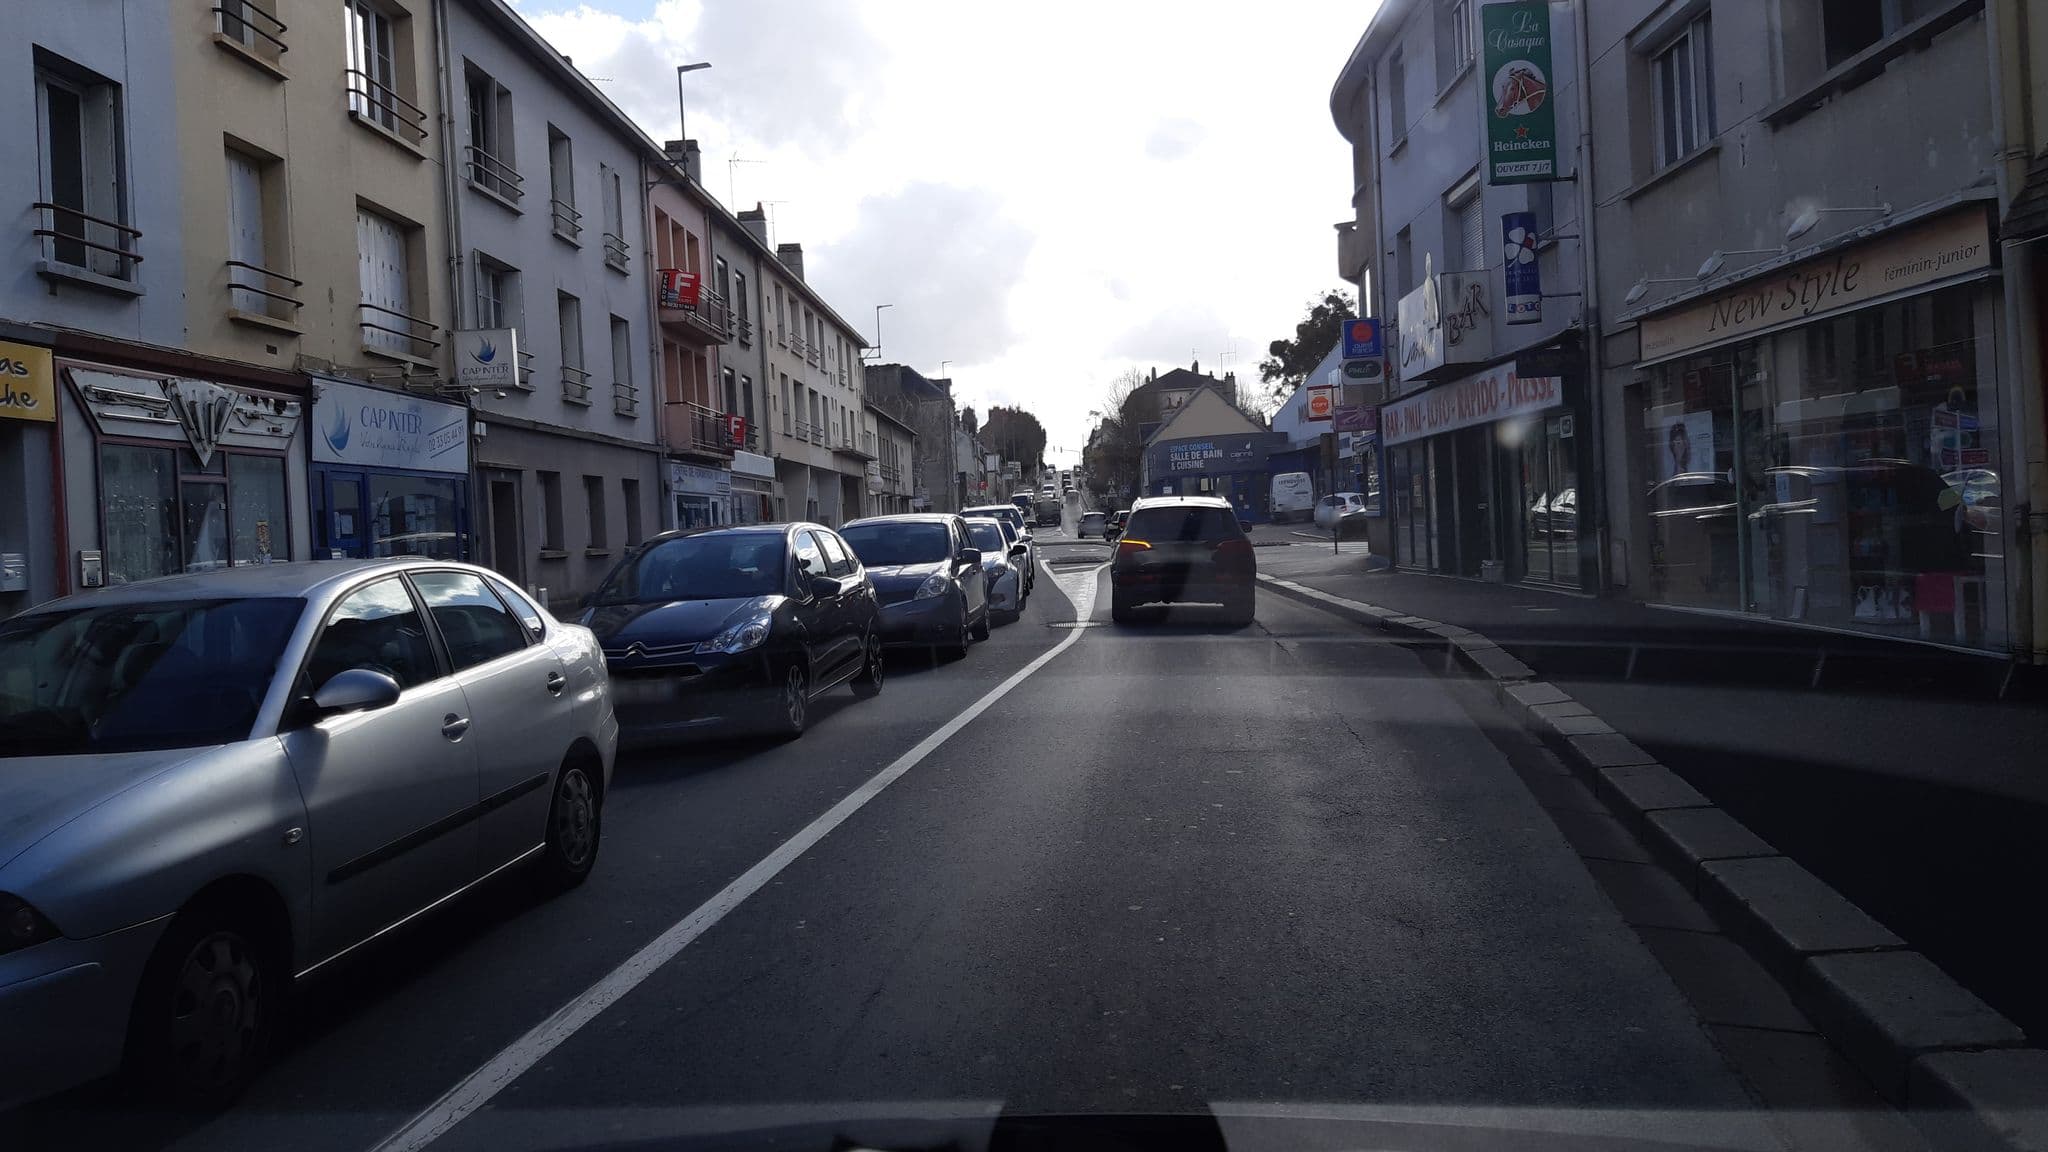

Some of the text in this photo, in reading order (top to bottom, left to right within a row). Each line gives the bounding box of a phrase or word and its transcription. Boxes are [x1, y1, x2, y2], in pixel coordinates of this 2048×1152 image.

[1512, 10, 1539, 33] La
[1488, 29, 1545, 55] Casaque
[1494, 139, 1551, 153] Heineken
[1497, 163, 1529, 174] OUVERT
[1884, 244, 1980, 282] féminin-junior
[661, 272, 669, 300] VENDU
[674, 273, 695, 292] F
[1707, 257, 1862, 333] New Style
[1446, 283, 1488, 346] BAR
[1385, 408, 1399, 439] BAR
[1456, 376, 1499, 419] RAPIDO
[731, 416, 743, 433] F
[1170, 449, 1223, 462] SALLE DE BAIN
[1171, 460, 1205, 471] & CUISINE
